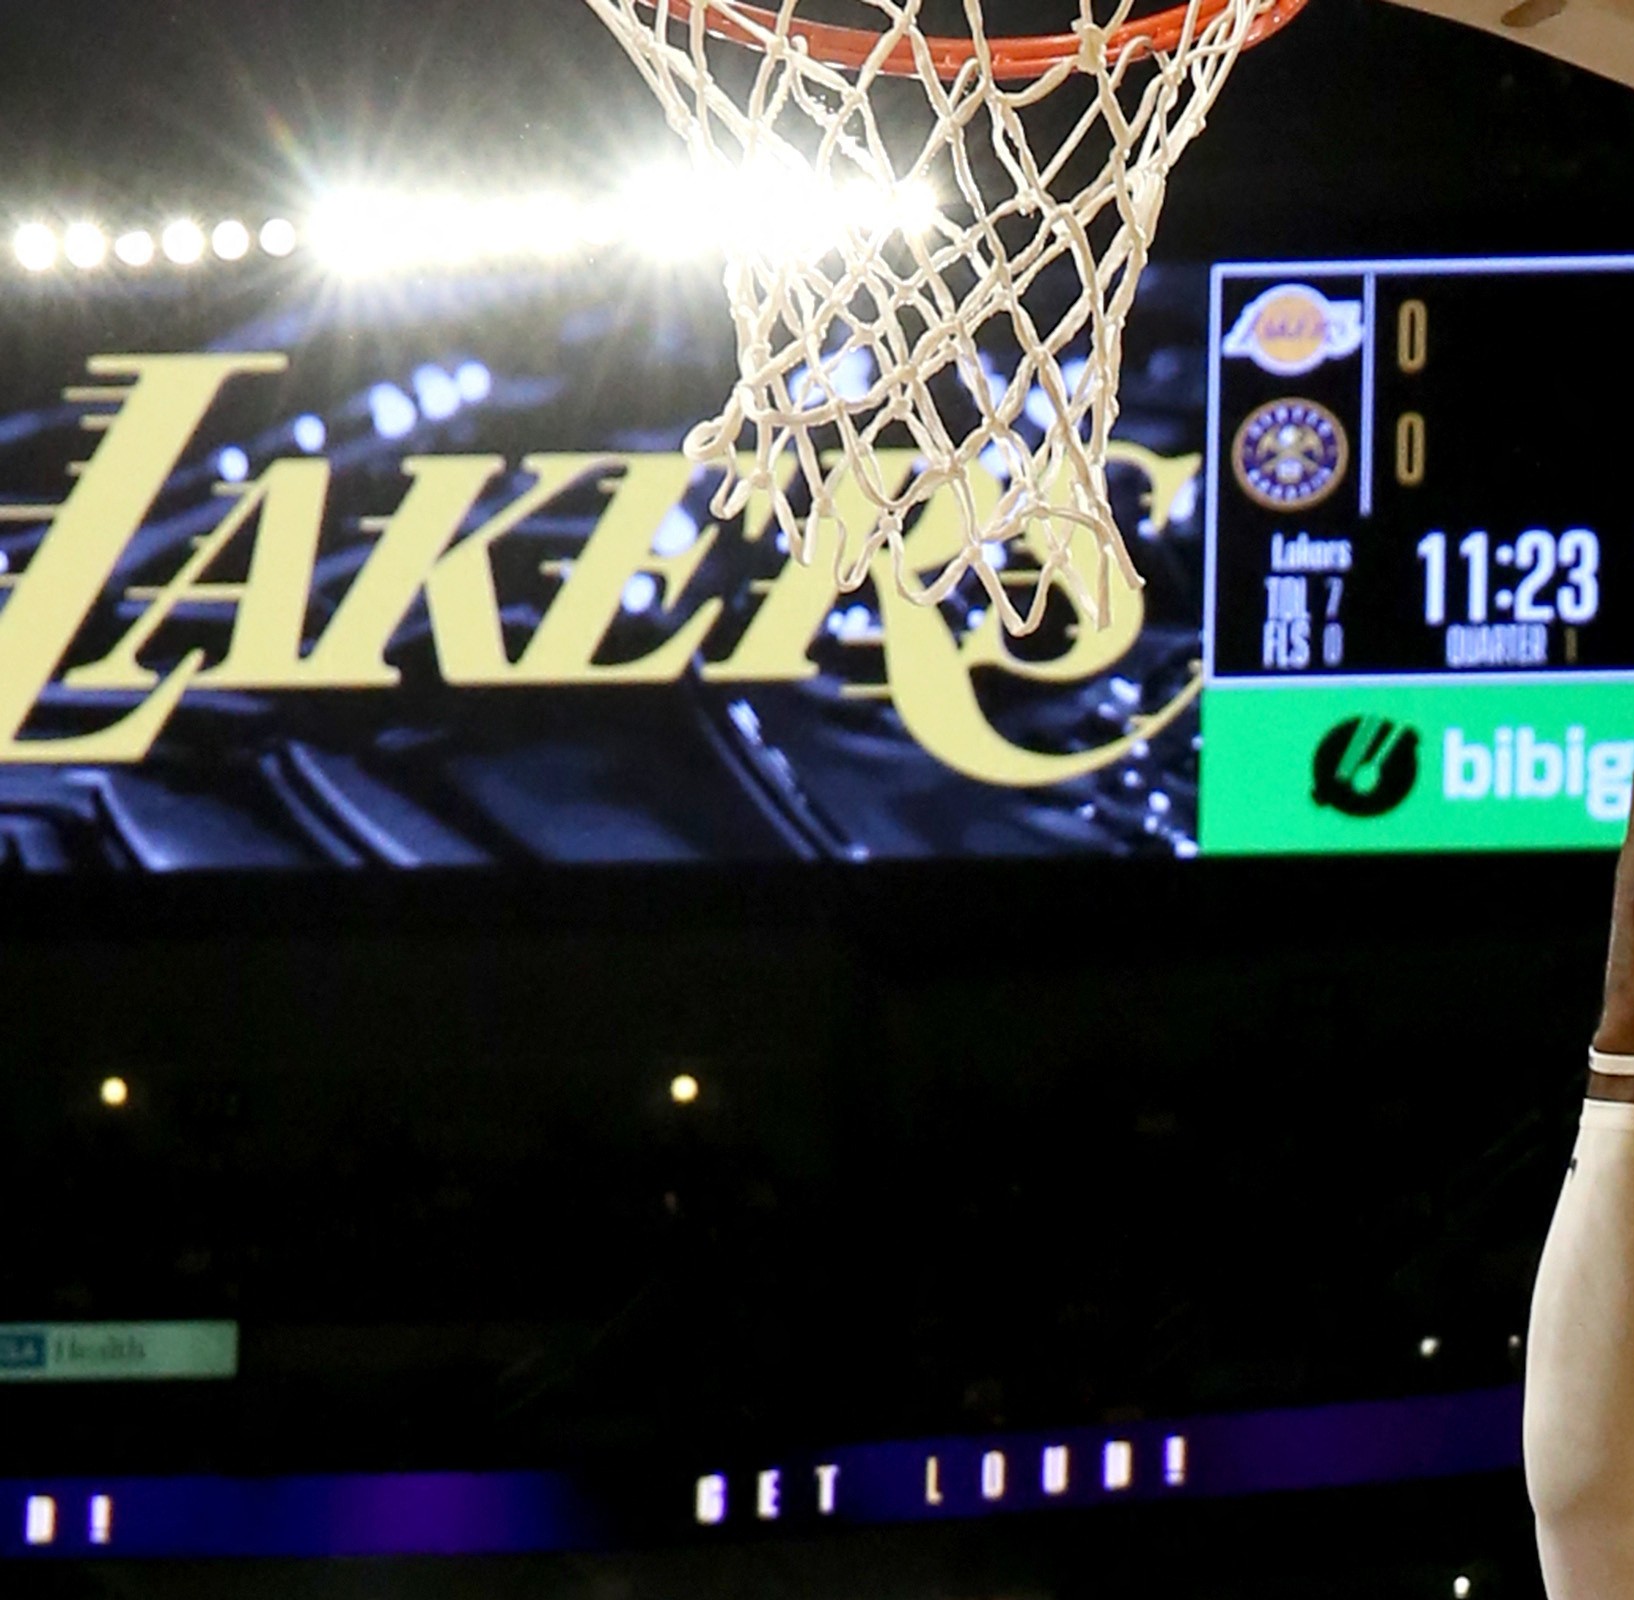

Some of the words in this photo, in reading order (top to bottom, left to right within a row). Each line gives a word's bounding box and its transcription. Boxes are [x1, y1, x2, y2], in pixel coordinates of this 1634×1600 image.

[1399, 299, 1427, 374] 0
[1397, 412, 1424, 486] 0
[0, 352, 1203, 788] LAKERS
[1417, 529, 1599, 626] 11:23
[696, 1465, 839, 1524] GET
